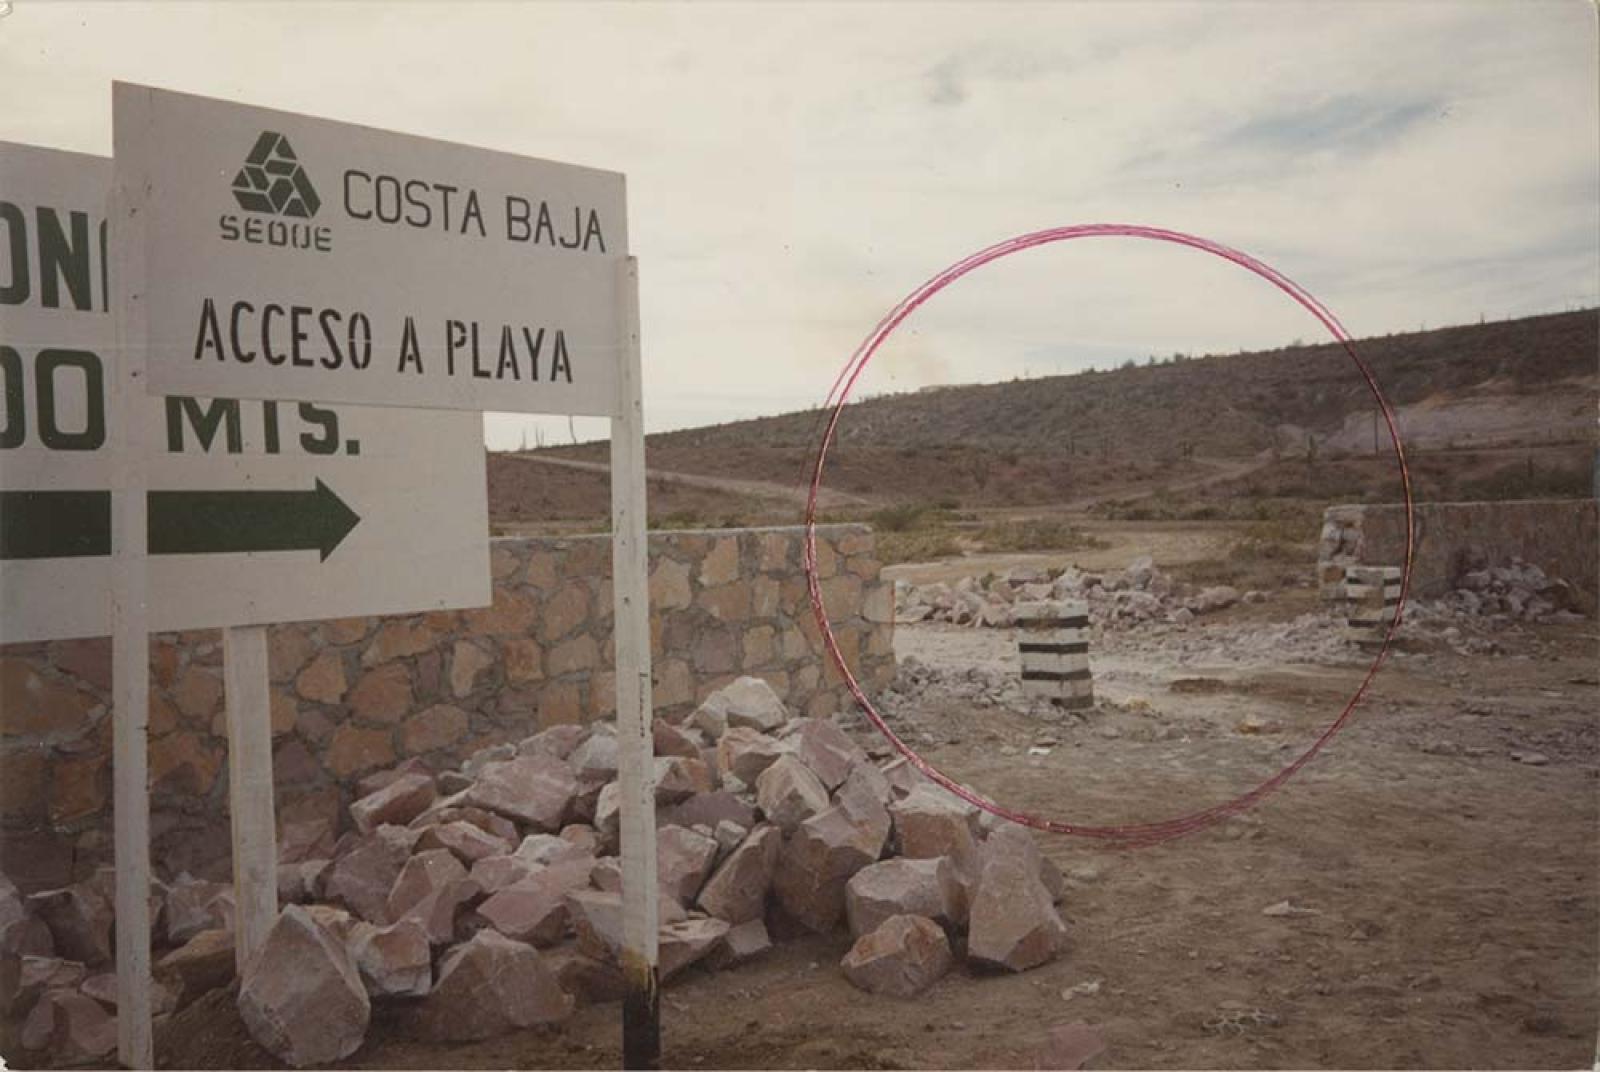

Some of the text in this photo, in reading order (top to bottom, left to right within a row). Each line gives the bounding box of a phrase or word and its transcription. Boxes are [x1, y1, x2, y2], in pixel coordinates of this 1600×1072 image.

[343, 170, 606, 253] COSTA BAJA
[0, 202, 109, 313] ON
[194, 298, 573, 383] ACCESO A PLAYA
